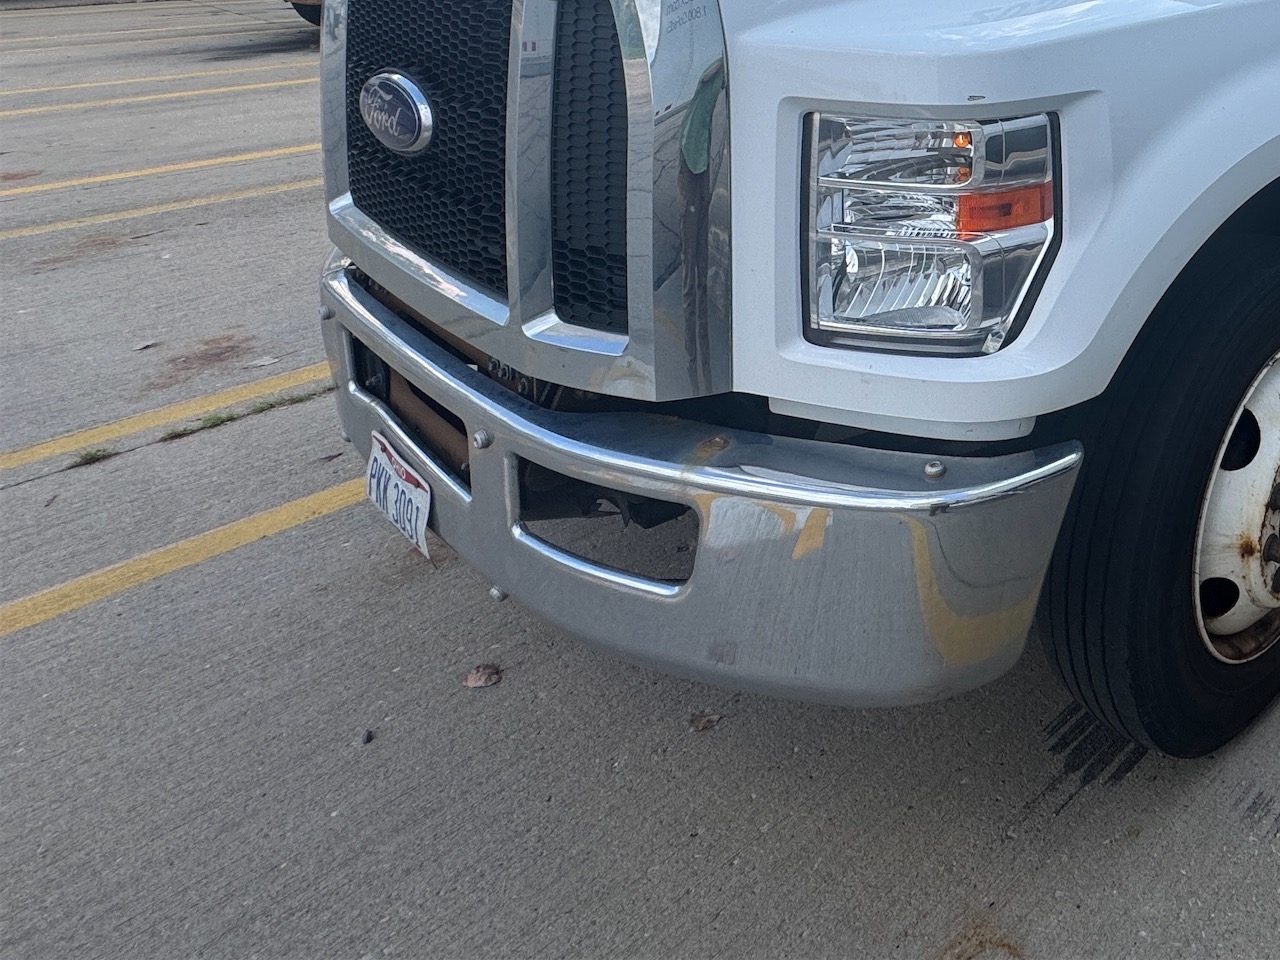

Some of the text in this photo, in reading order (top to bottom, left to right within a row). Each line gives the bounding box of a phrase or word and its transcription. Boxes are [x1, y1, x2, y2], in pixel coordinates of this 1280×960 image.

[365, 86, 401, 136] Ford
[368, 455, 422, 550] PKK 3091
